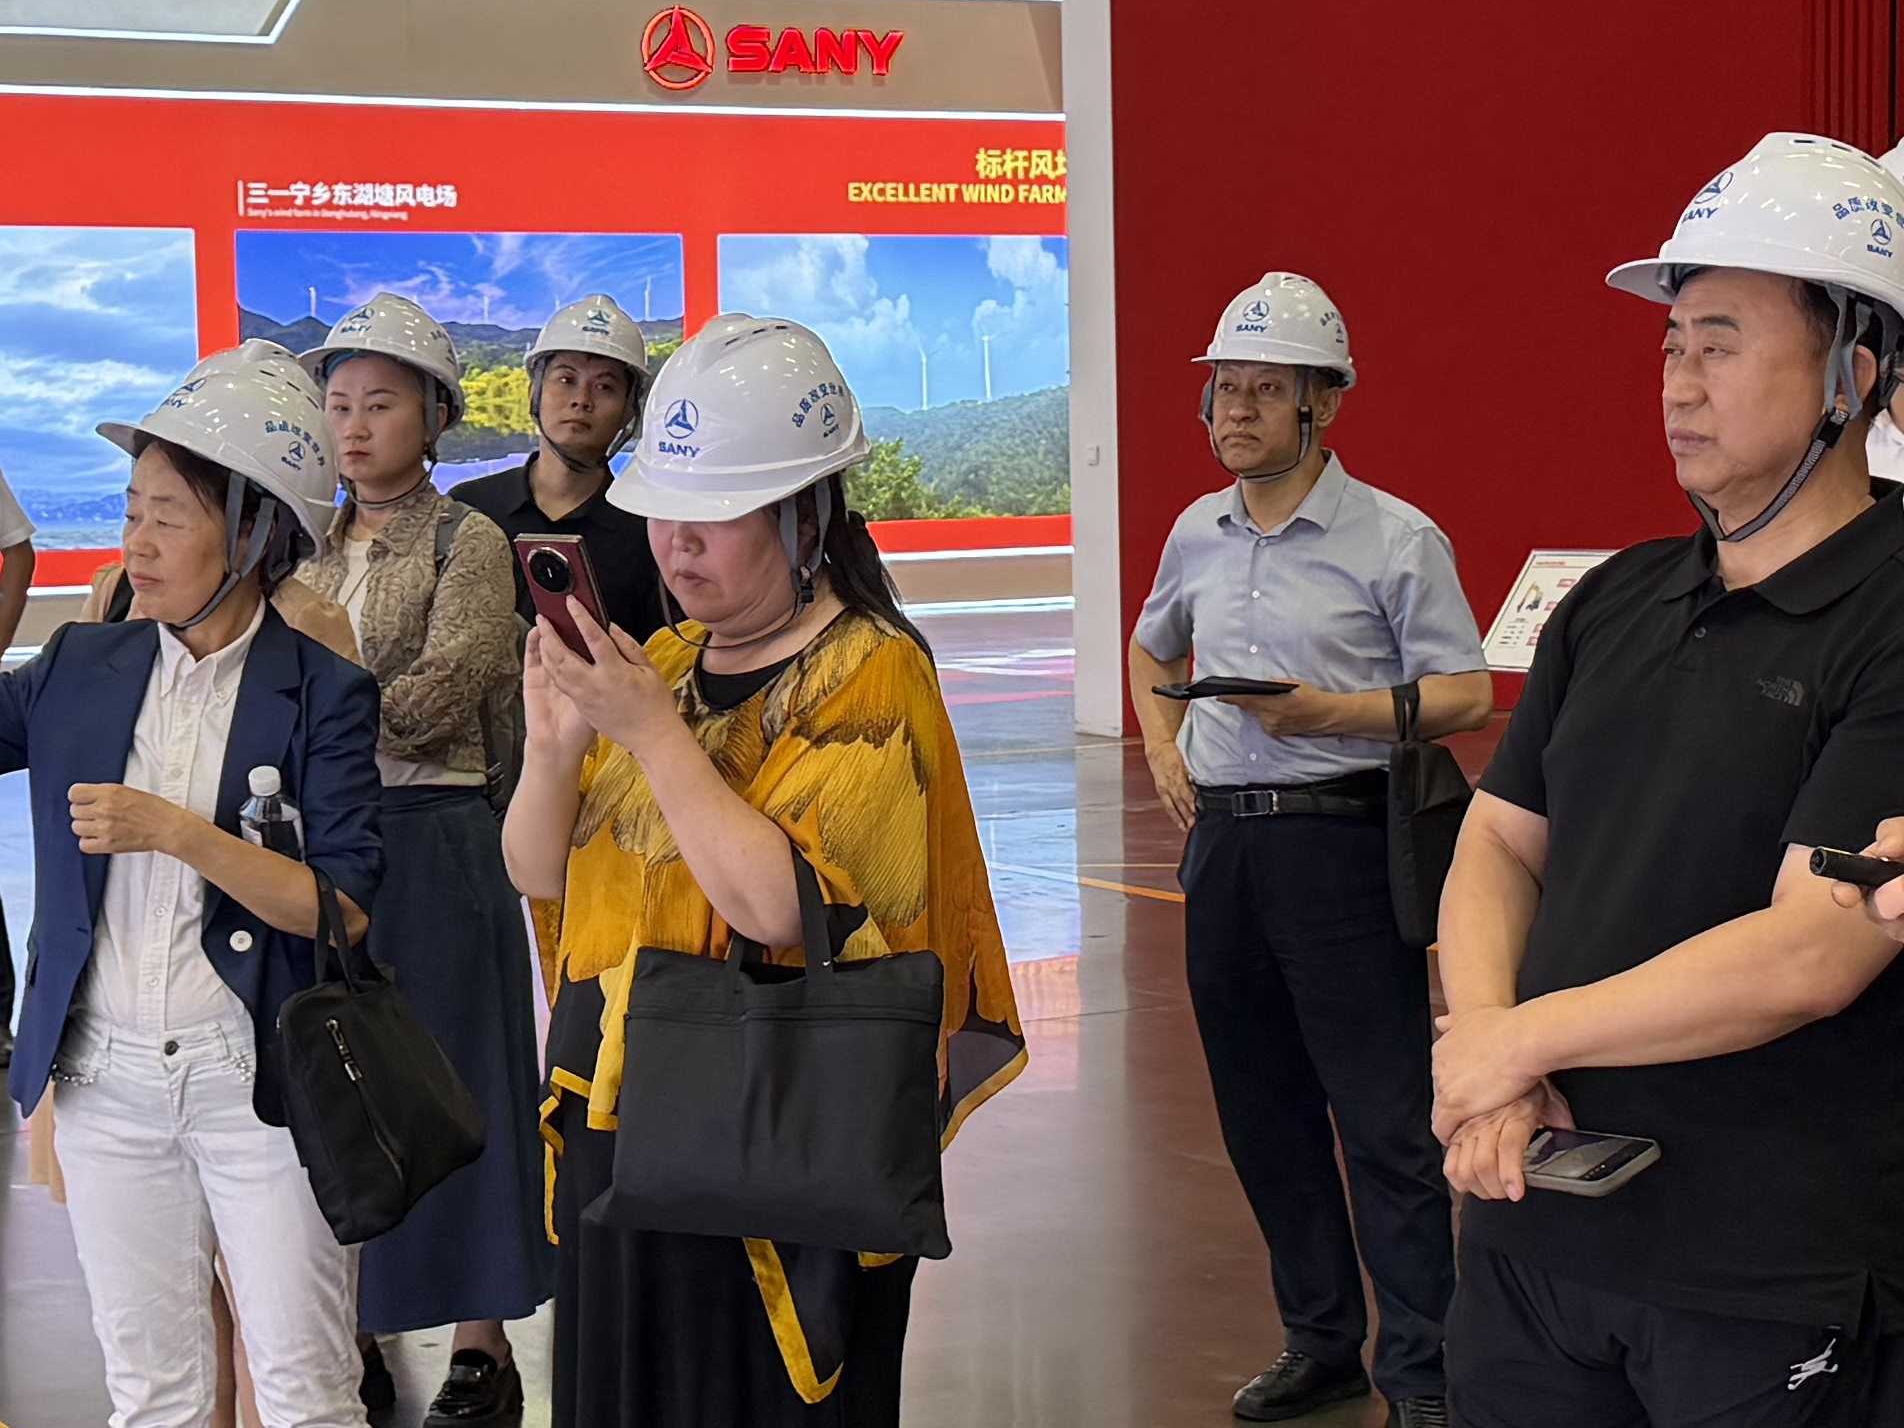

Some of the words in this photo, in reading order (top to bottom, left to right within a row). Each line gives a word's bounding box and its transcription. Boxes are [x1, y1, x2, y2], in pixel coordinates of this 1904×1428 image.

[725, 24, 904, 76] SANY
[847, 182, 960, 203] EXCELLENT
[961, 183, 1015, 204] WIND
[1017, 184, 1066, 204] FARM
[658, 441, 701, 458] SANY
